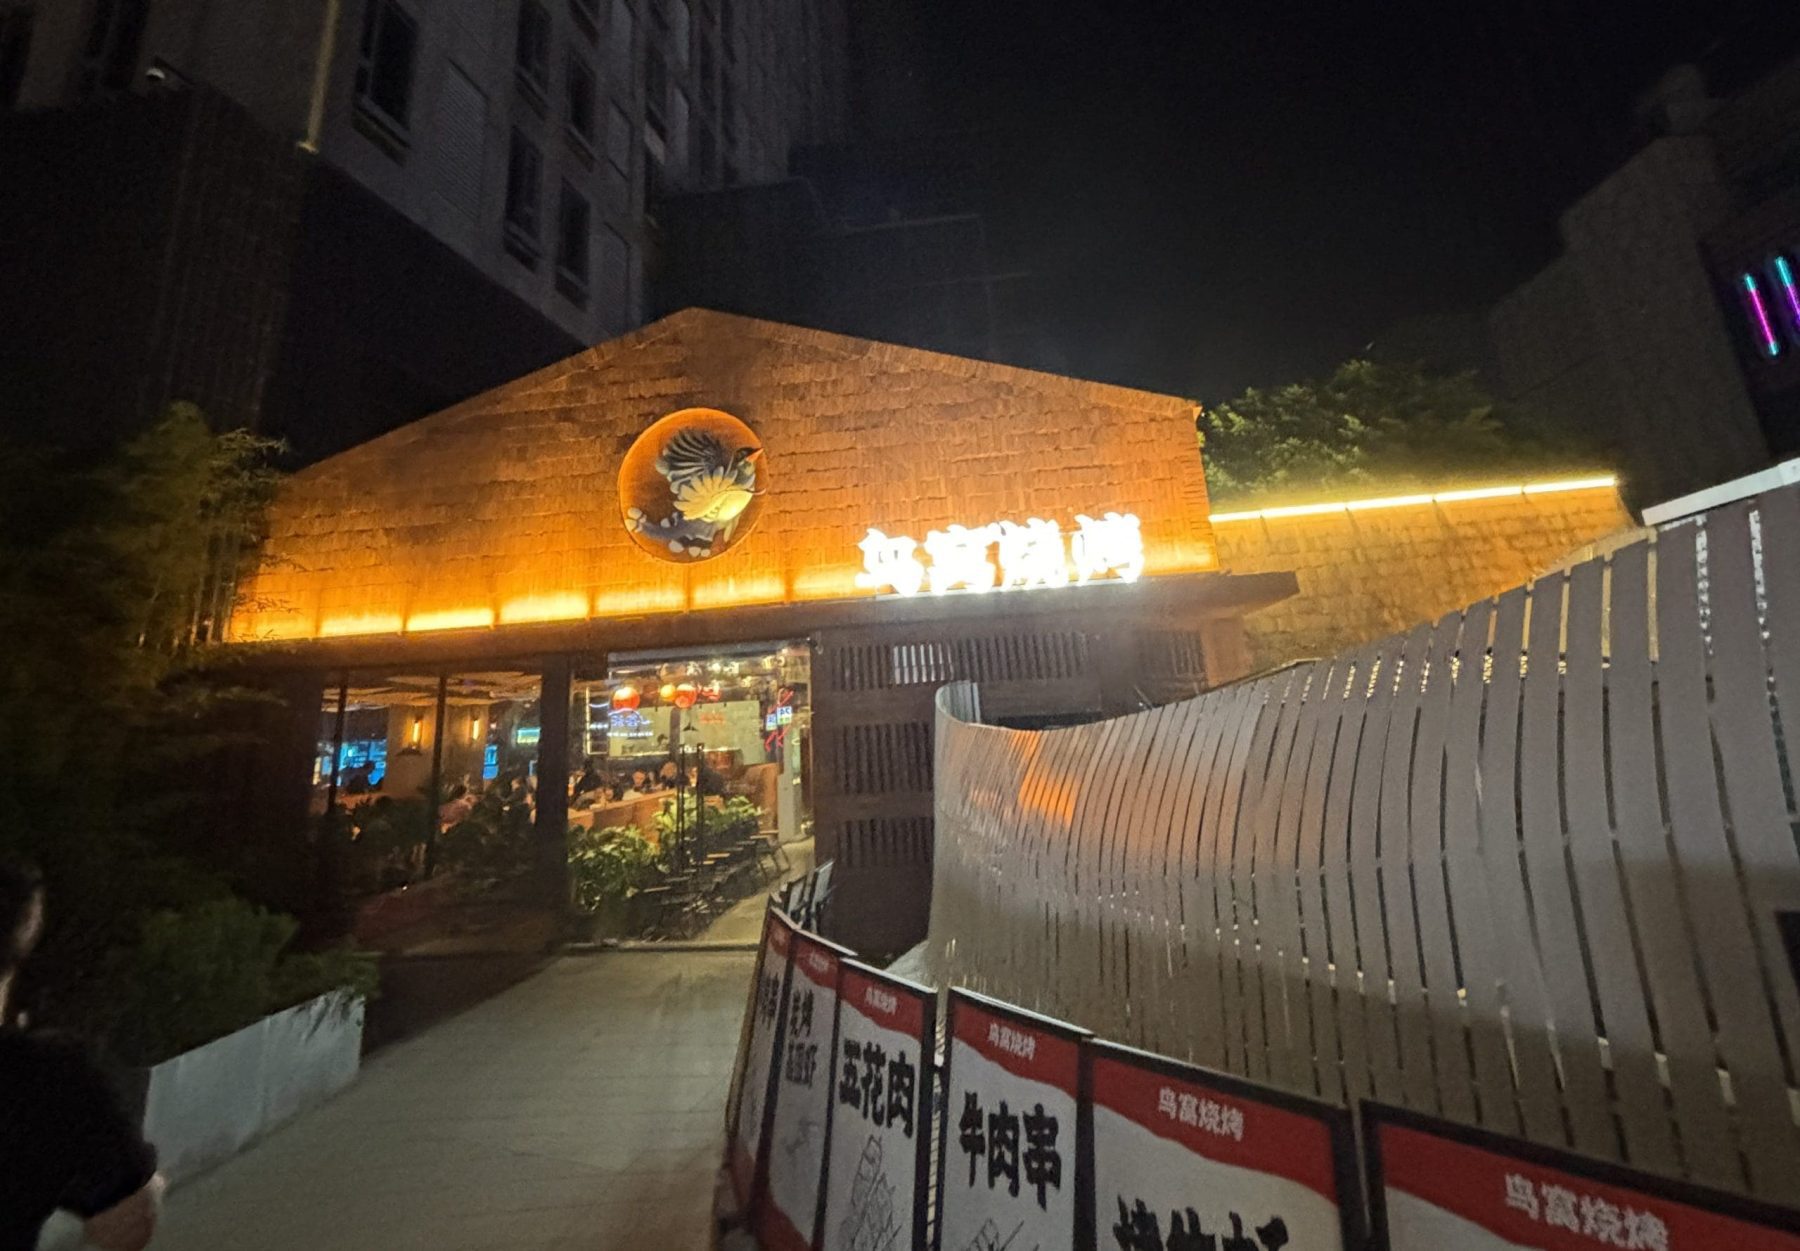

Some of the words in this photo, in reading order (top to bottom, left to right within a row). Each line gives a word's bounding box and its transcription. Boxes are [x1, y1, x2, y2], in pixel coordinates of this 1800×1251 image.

[839, 1038, 916, 1139] 五花肉
[959, 1089, 1062, 1213] 牛肉串
